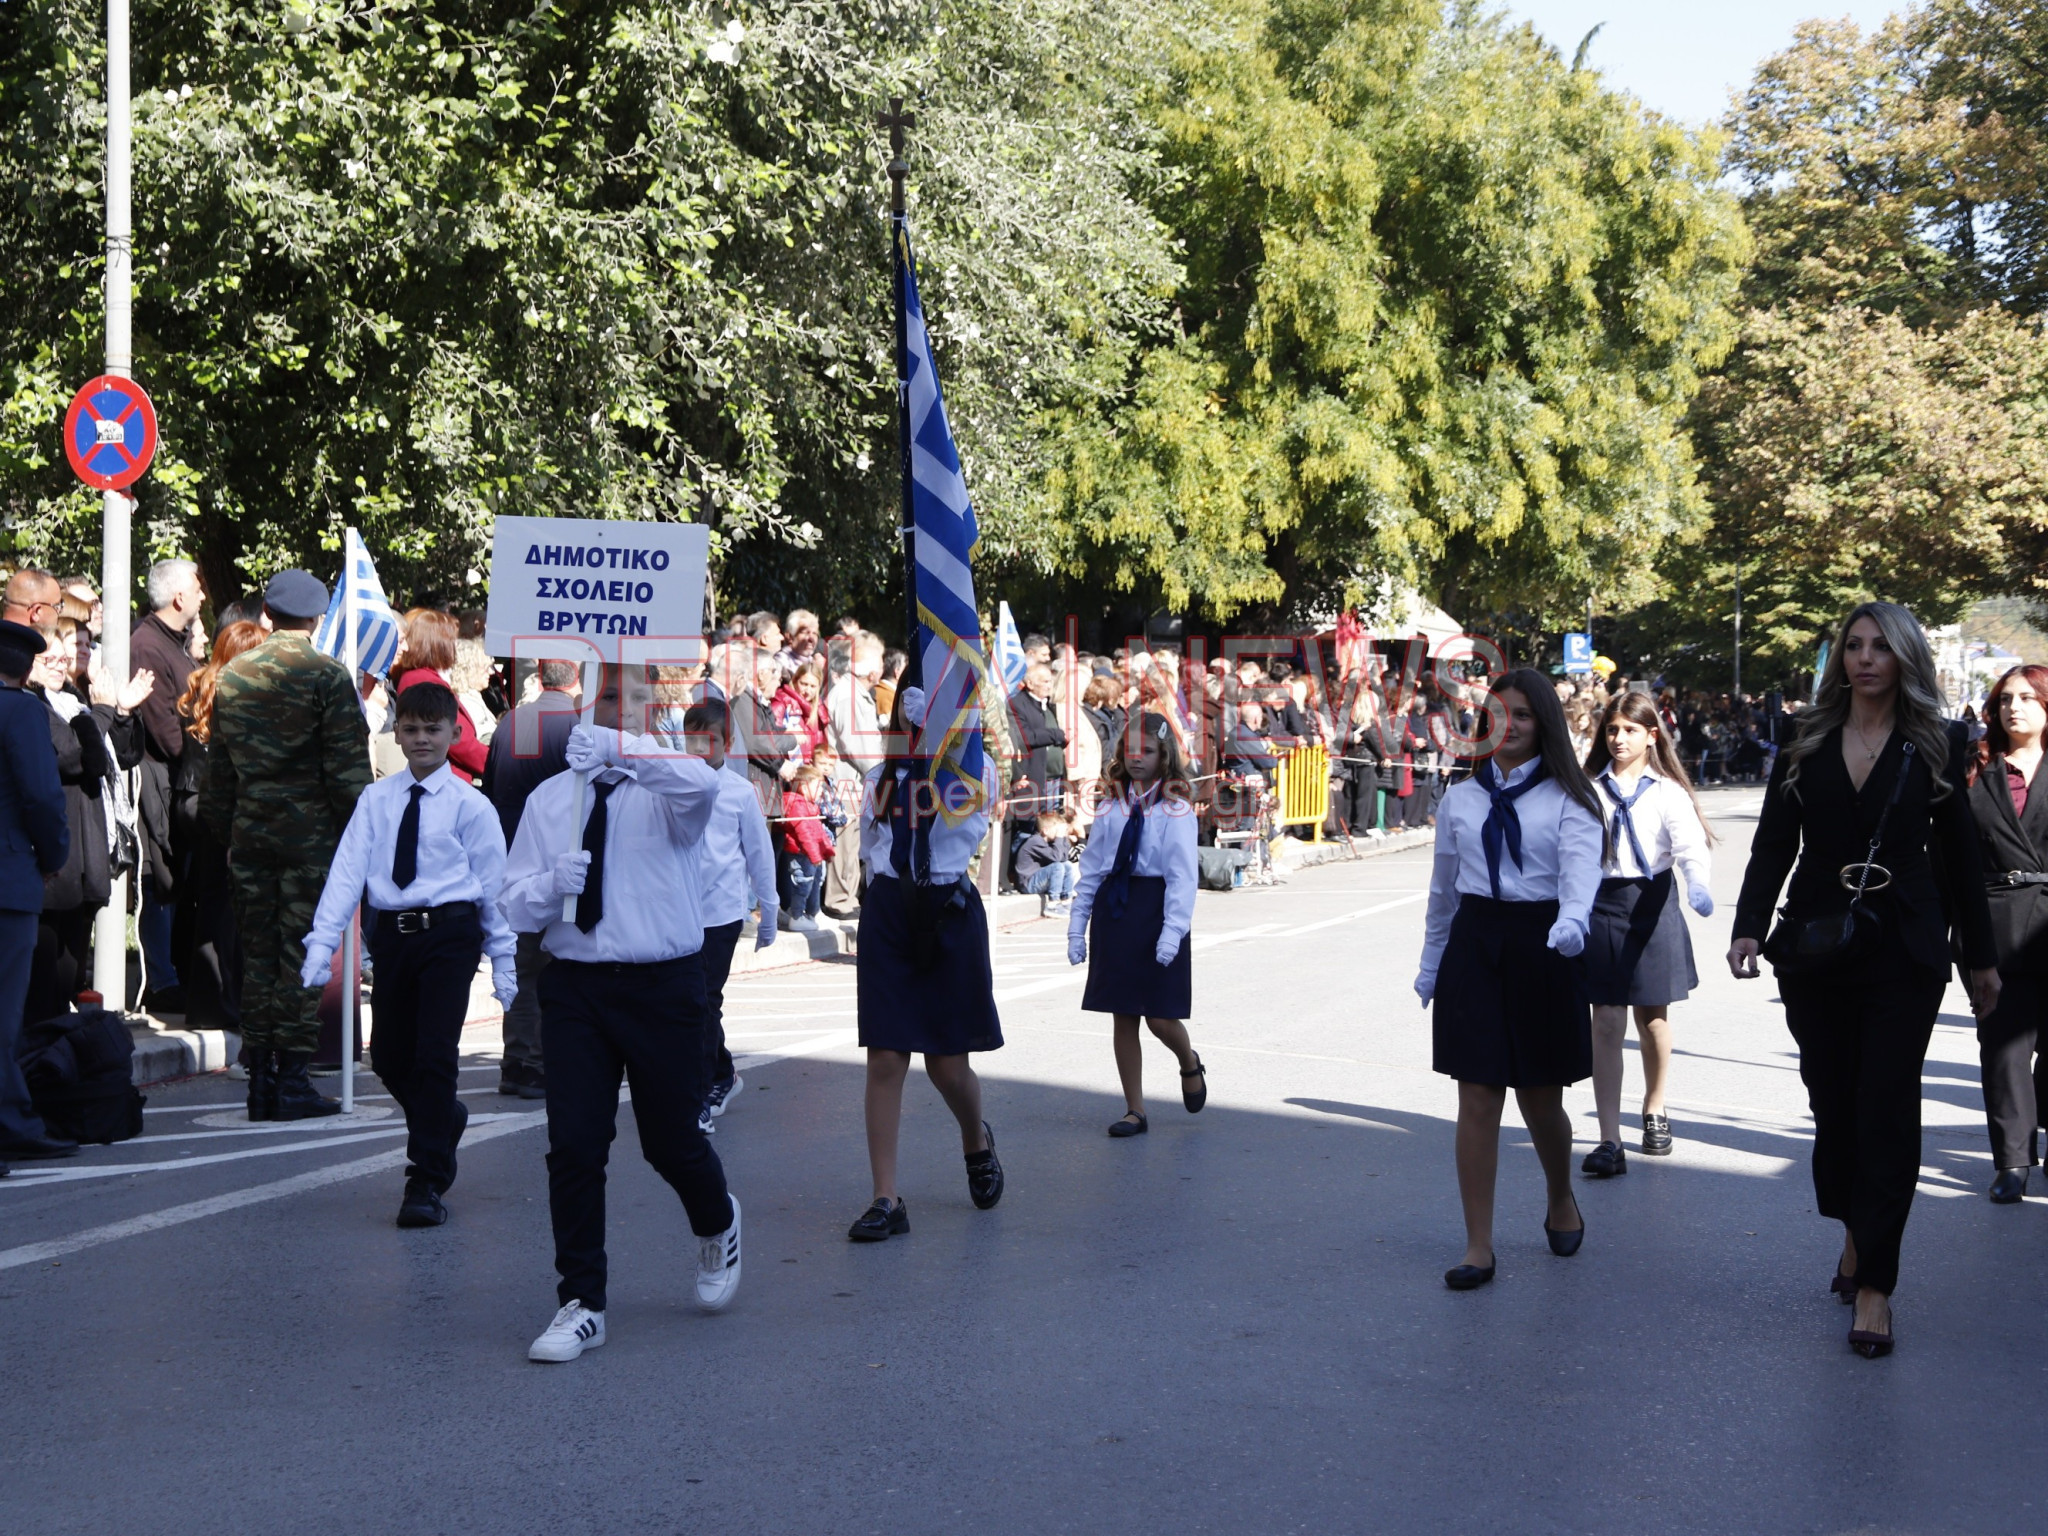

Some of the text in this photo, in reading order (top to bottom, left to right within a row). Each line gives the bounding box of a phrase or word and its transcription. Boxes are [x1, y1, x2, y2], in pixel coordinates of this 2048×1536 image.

[525, 544, 670, 571] ΔΗΜΟΤΙΚΟ
[536, 577, 654, 603] ΣΧΟΛΕΙΟ
[538, 611, 648, 636] ΒΡΥΤΩΝ
